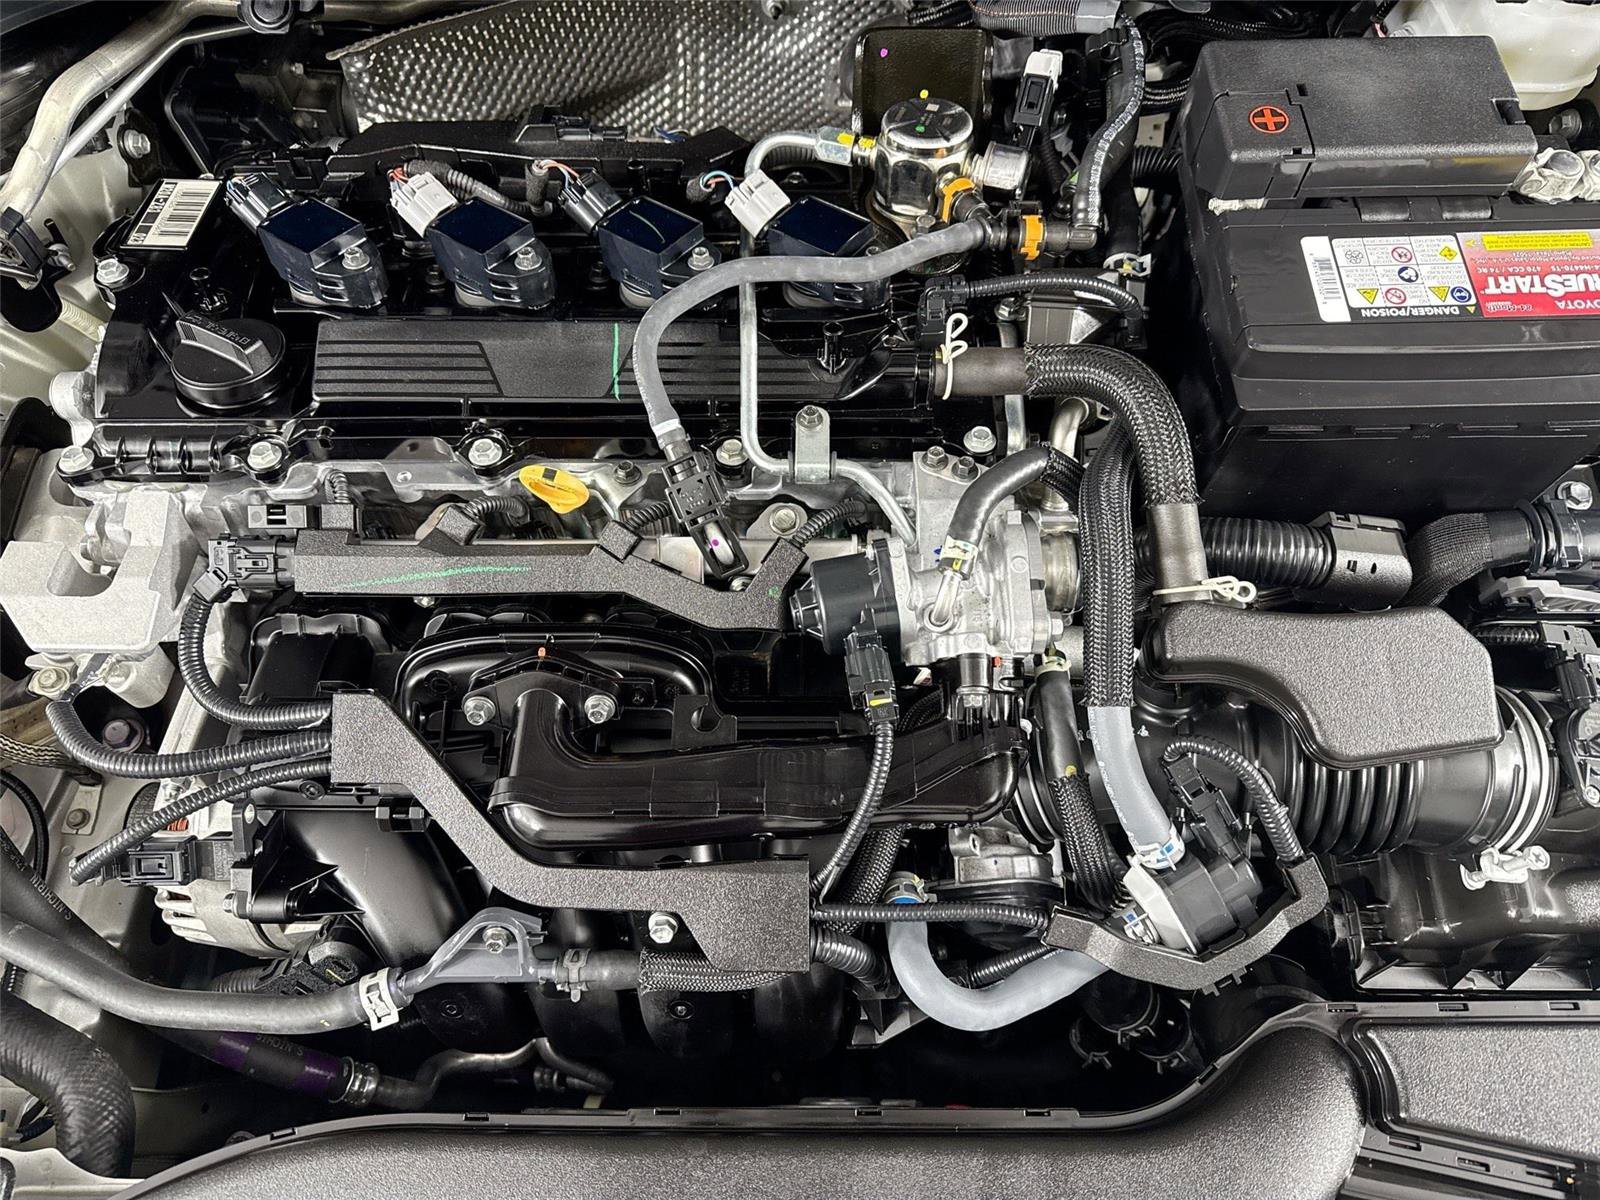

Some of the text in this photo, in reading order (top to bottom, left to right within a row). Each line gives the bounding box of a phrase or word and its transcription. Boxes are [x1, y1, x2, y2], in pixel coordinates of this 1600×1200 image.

[1551, 264, 1600, 272] 4-H4470-TS
[1485, 273, 1600, 297] RUESTART
[1555, 299, 1600, 309] OYOTA
[1360, 306, 1460, 317] DANGER/POISON
